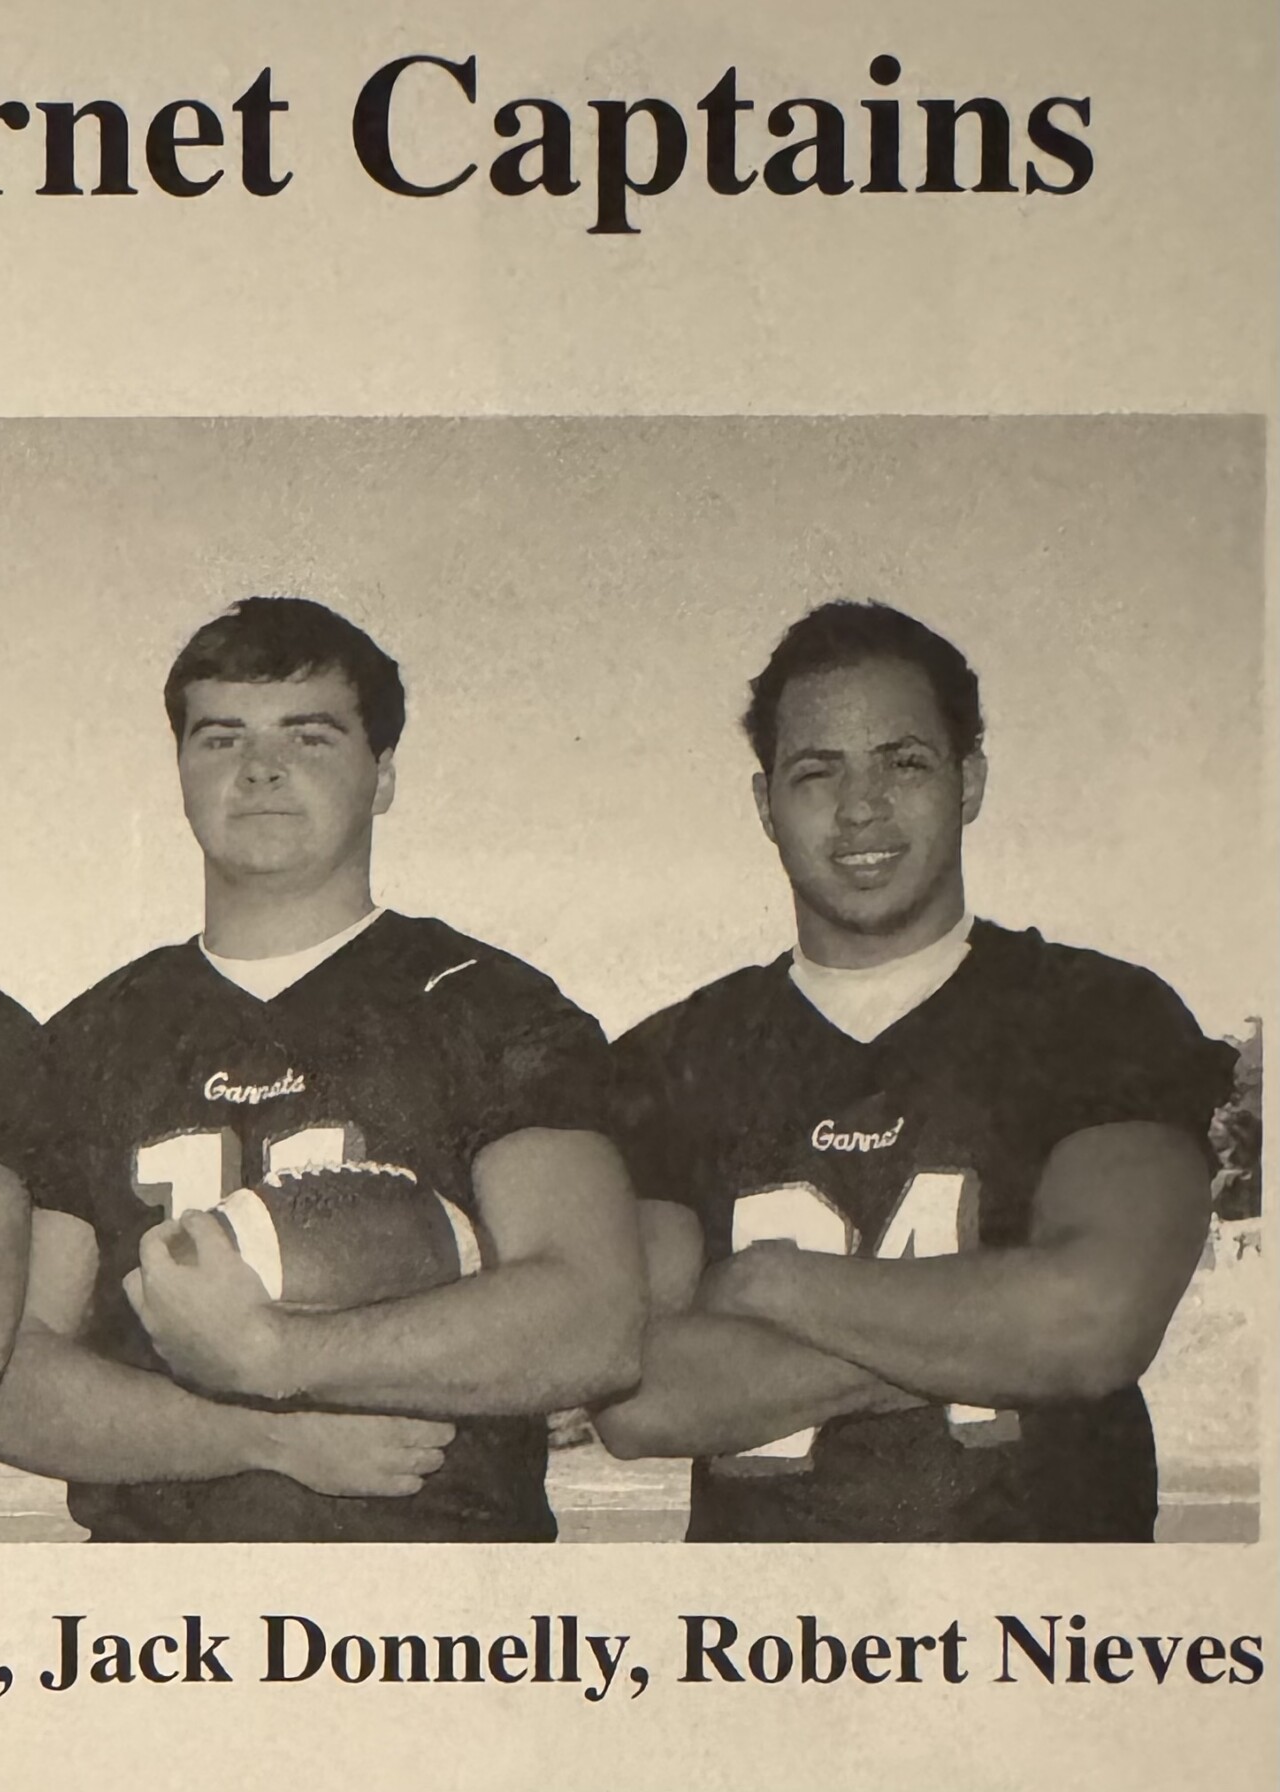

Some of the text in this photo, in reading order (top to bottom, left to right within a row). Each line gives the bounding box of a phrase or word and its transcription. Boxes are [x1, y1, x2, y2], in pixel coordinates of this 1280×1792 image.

[353, 55, 1093, 234] Captains
[40, 1616, 232, 1690] Jack
[260, 1616, 648, 1701] Donnelly,
[678, 1616, 968, 1685] Robert
[995, 1615, 1263, 1685] Nieves
